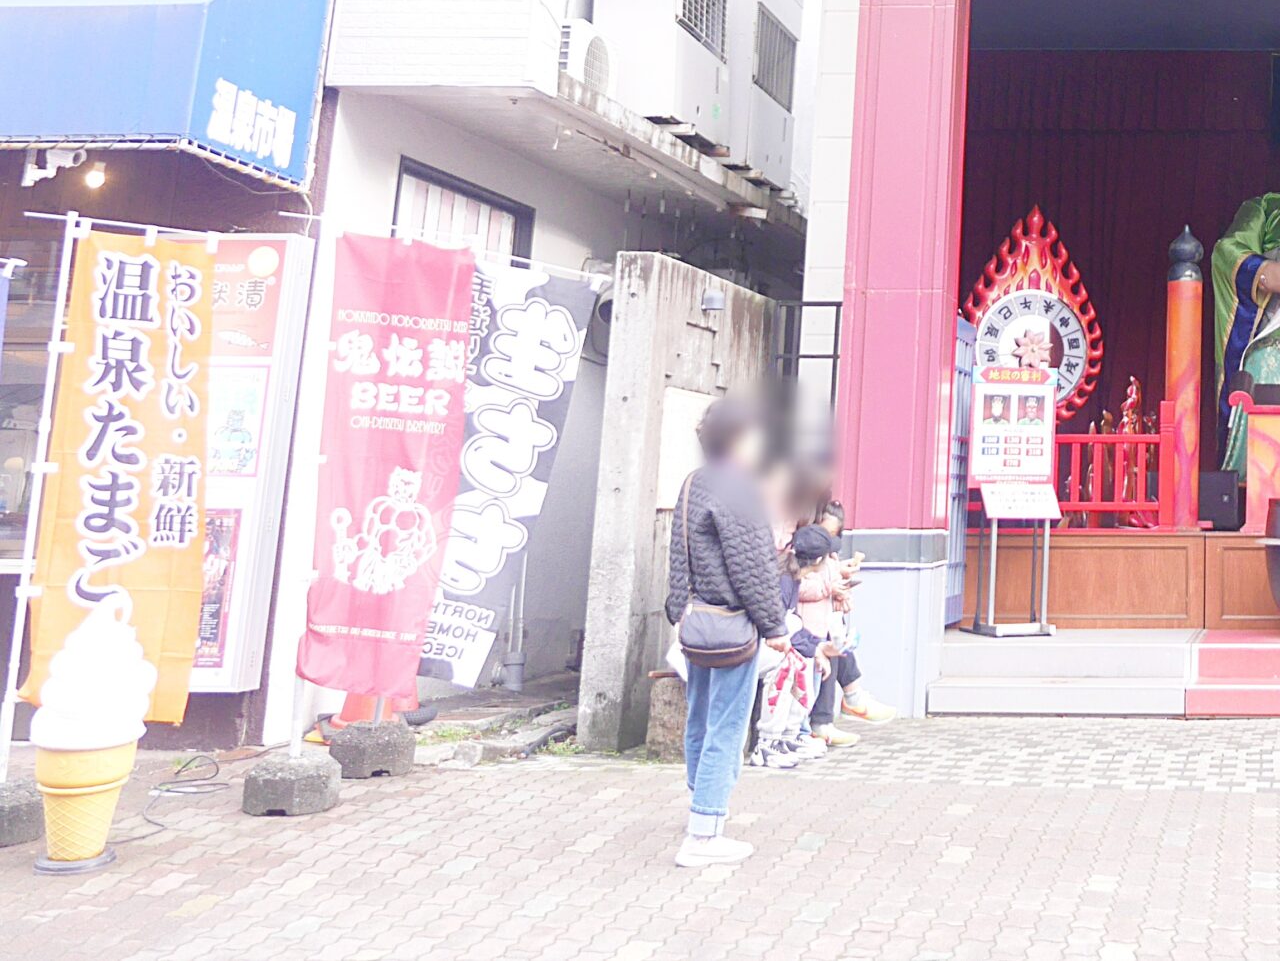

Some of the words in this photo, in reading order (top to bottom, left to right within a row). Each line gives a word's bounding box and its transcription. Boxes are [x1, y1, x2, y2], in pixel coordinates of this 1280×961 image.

[333, 329, 466, 384] 鬼伝説
[350, 380, 452, 417] BEER
[75, 255, 155, 602] 温泉たまご
[406, 419, 447, 435] BREWERY
